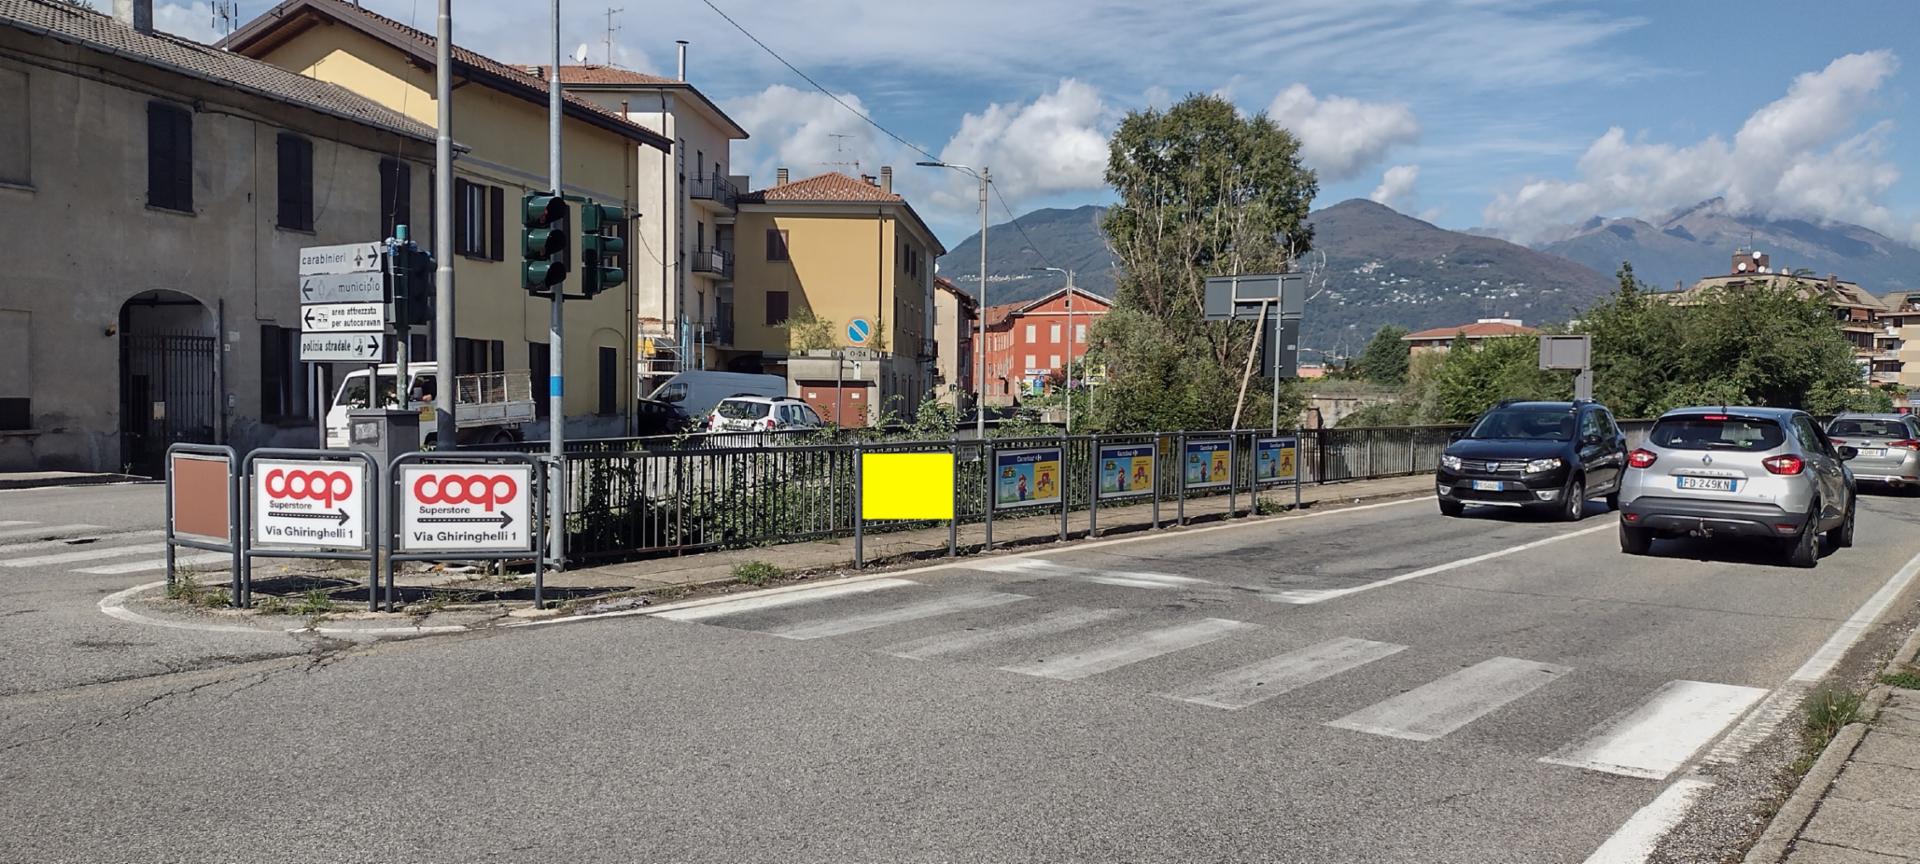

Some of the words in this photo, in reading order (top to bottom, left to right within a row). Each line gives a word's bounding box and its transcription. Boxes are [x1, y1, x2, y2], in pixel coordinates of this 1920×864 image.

[302, 252, 346, 265] carabinieri
[338, 281, 381, 293] municipio
[347, 306, 377, 315] attrezzata
[331, 320, 342, 328] per
[344, 318, 381, 327] autocaravan
[302, 340, 323, 354] polizia
[325, 339, 351, 351] stradale
[265, 468, 353, 509] coop
[414, 474, 517, 512] coop
[269, 500, 313, 510] Superstore
[419, 506, 470, 515] Superstore
[265, 526, 282, 536] Via
[284, 526, 346, 540] Ghiringhelli
[348, 530, 353, 538] 1
[413, 531, 433, 542] Via
[437, 531, 508, 543] Ghiringhelli
[511, 532, 517, 541] 1
